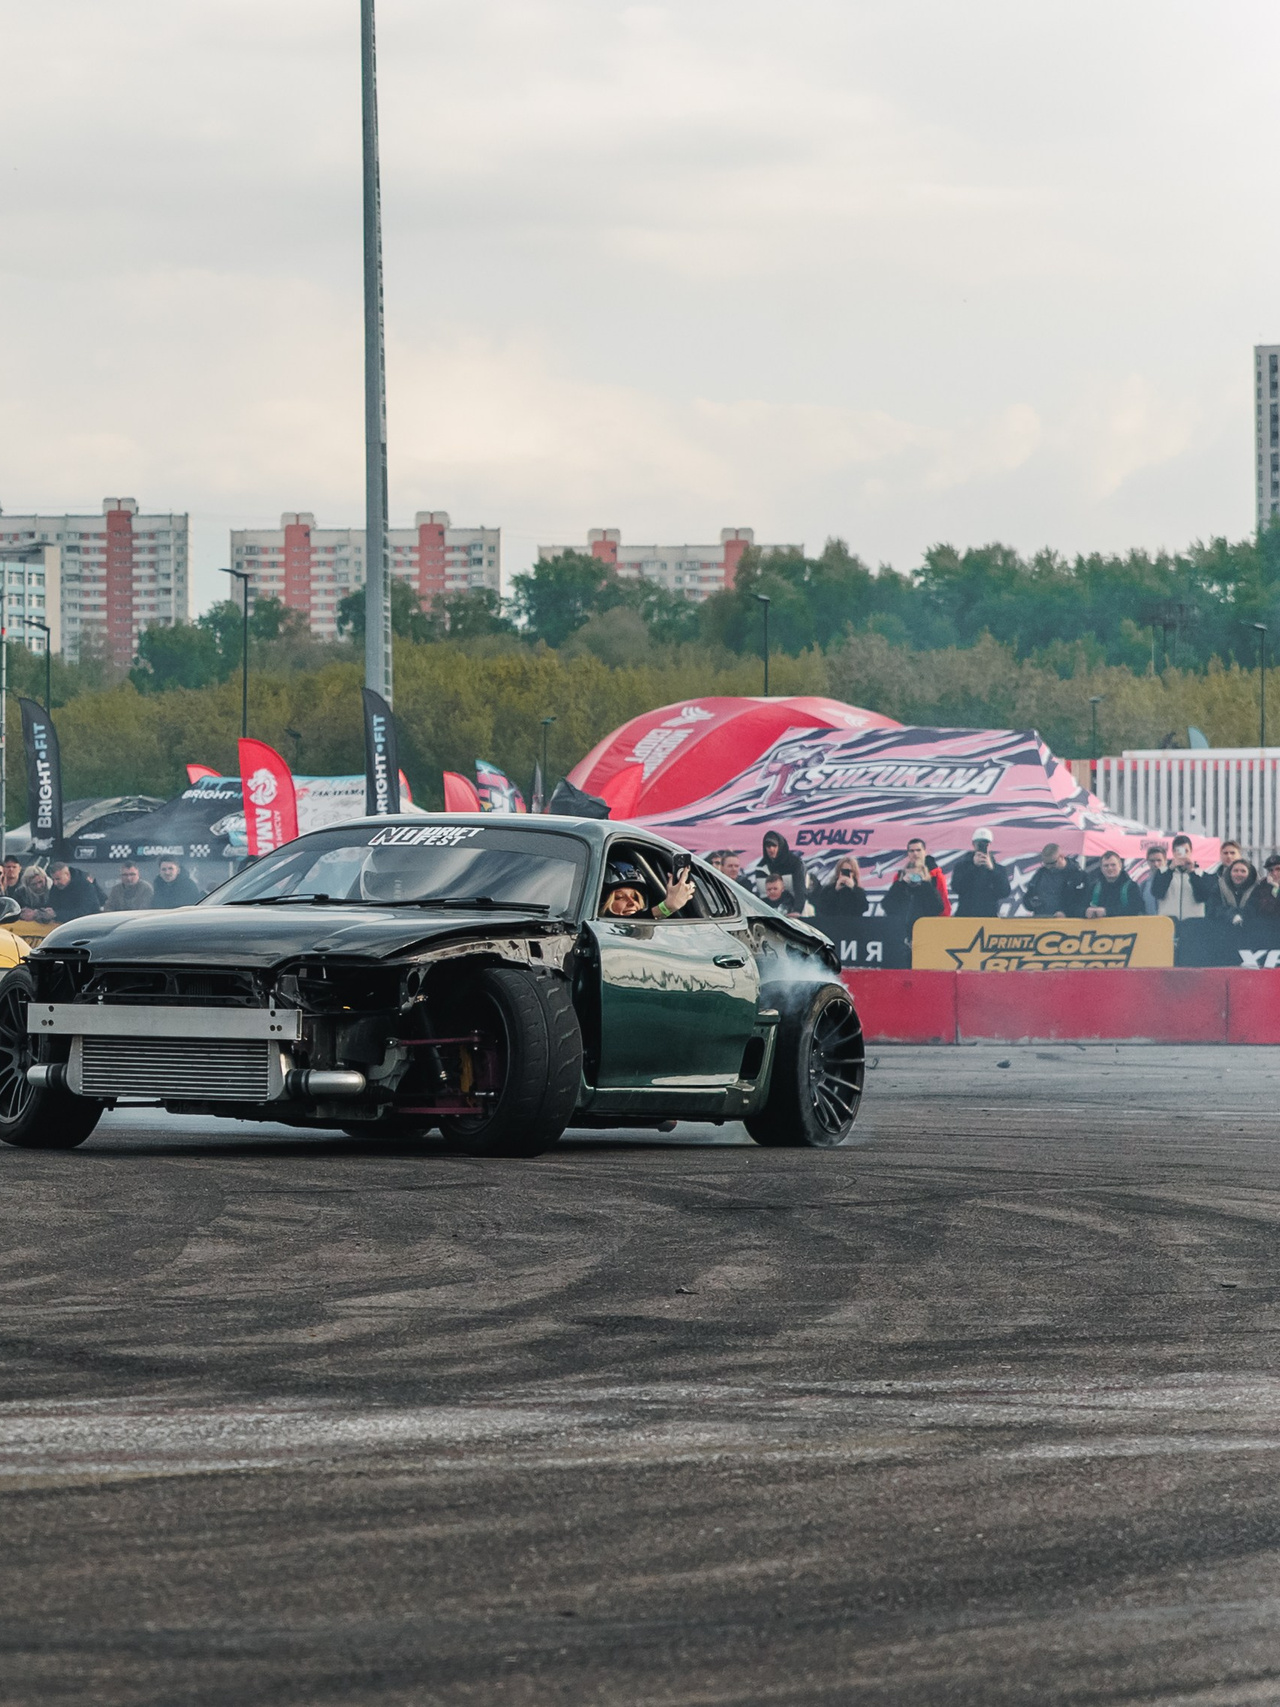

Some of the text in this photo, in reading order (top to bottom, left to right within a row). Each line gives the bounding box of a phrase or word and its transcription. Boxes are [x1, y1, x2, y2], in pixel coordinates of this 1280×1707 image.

[420, 826, 485, 838] DRIFT
[795, 829, 875, 846] EXHAUST
[414, 835, 467, 846] FEST
[1035, 928, 1135, 956] Color
